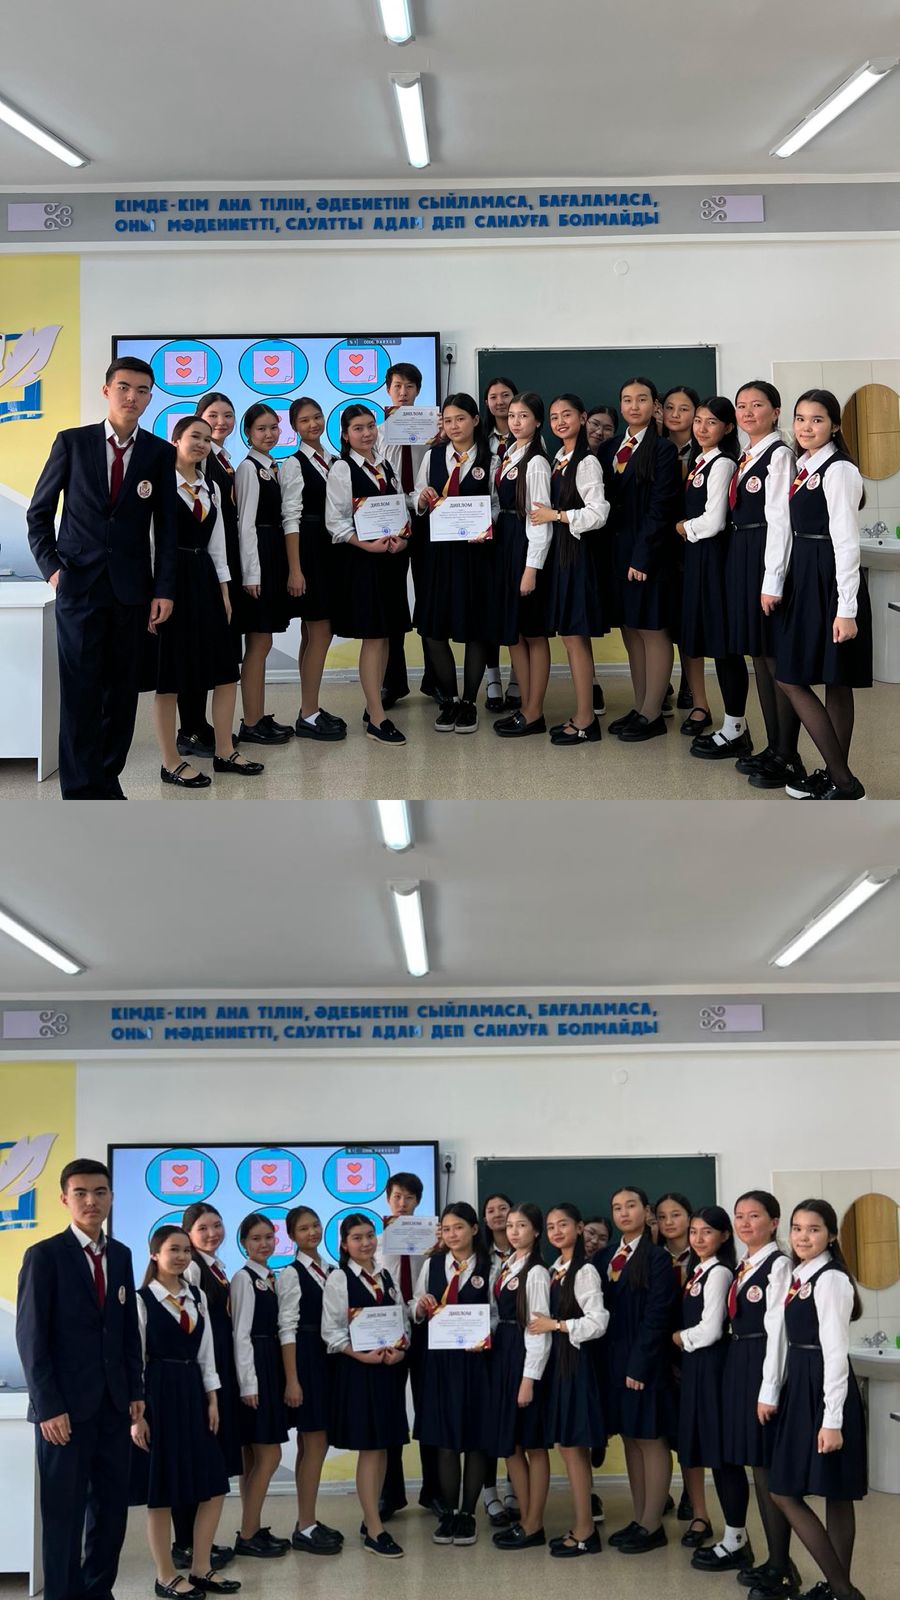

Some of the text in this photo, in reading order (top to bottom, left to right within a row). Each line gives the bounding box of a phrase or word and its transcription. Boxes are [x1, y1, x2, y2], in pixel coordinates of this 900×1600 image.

[114, 193, 659, 213] КІМДЕ-КІМ АНА ТІЛІН, ӘДЕБИЕТІН СЫЙЛАМАСА, БАҒАЛАМАСА,
[167, 217, 280, 233] МӘДЕНИЕТТІ,
[285, 217, 363, 231] САУАТТЫ
[432, 216, 465, 230] ДЕП
[474, 214, 549, 229] САНАУҒА
[559, 210, 659, 226] БОЛМАЙДЫ
[111, 1002, 657, 1021] КІМДЕ-КІМ АНА ТІЛІН, ӘДЕБИЕТІН СЫЙЛАМАСА, БАҒАЛАМАСА,
[163, 1025, 277, 1041] МӘДЕНИЕТТІ,
[283, 1025, 362, 1039] САУАТТЫ
[431, 1024, 464, 1039] ДЕП
[473, 1023, 548, 1037] САНАУҒА
[557, 1019, 657, 1036] БОЛМАЙДЫ
